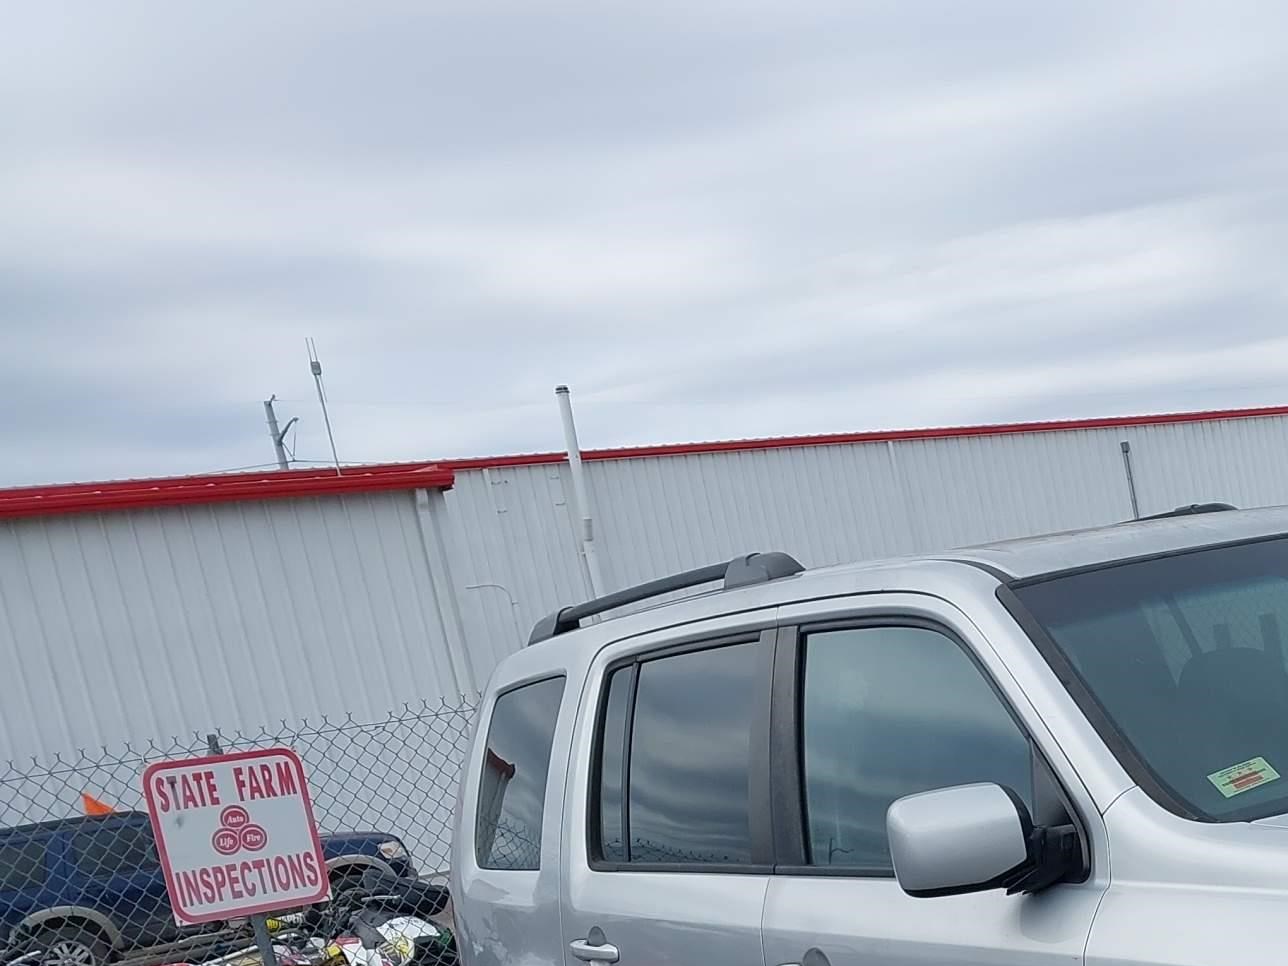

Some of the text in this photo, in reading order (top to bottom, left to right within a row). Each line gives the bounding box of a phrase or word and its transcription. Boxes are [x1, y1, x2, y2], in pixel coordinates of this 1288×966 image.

[155, 761, 297, 812] STATE FARM
[227, 815, 244, 824] Auto
[220, 834, 261, 848] Life Fire
[175, 851, 319, 908] INSPECTIONS
